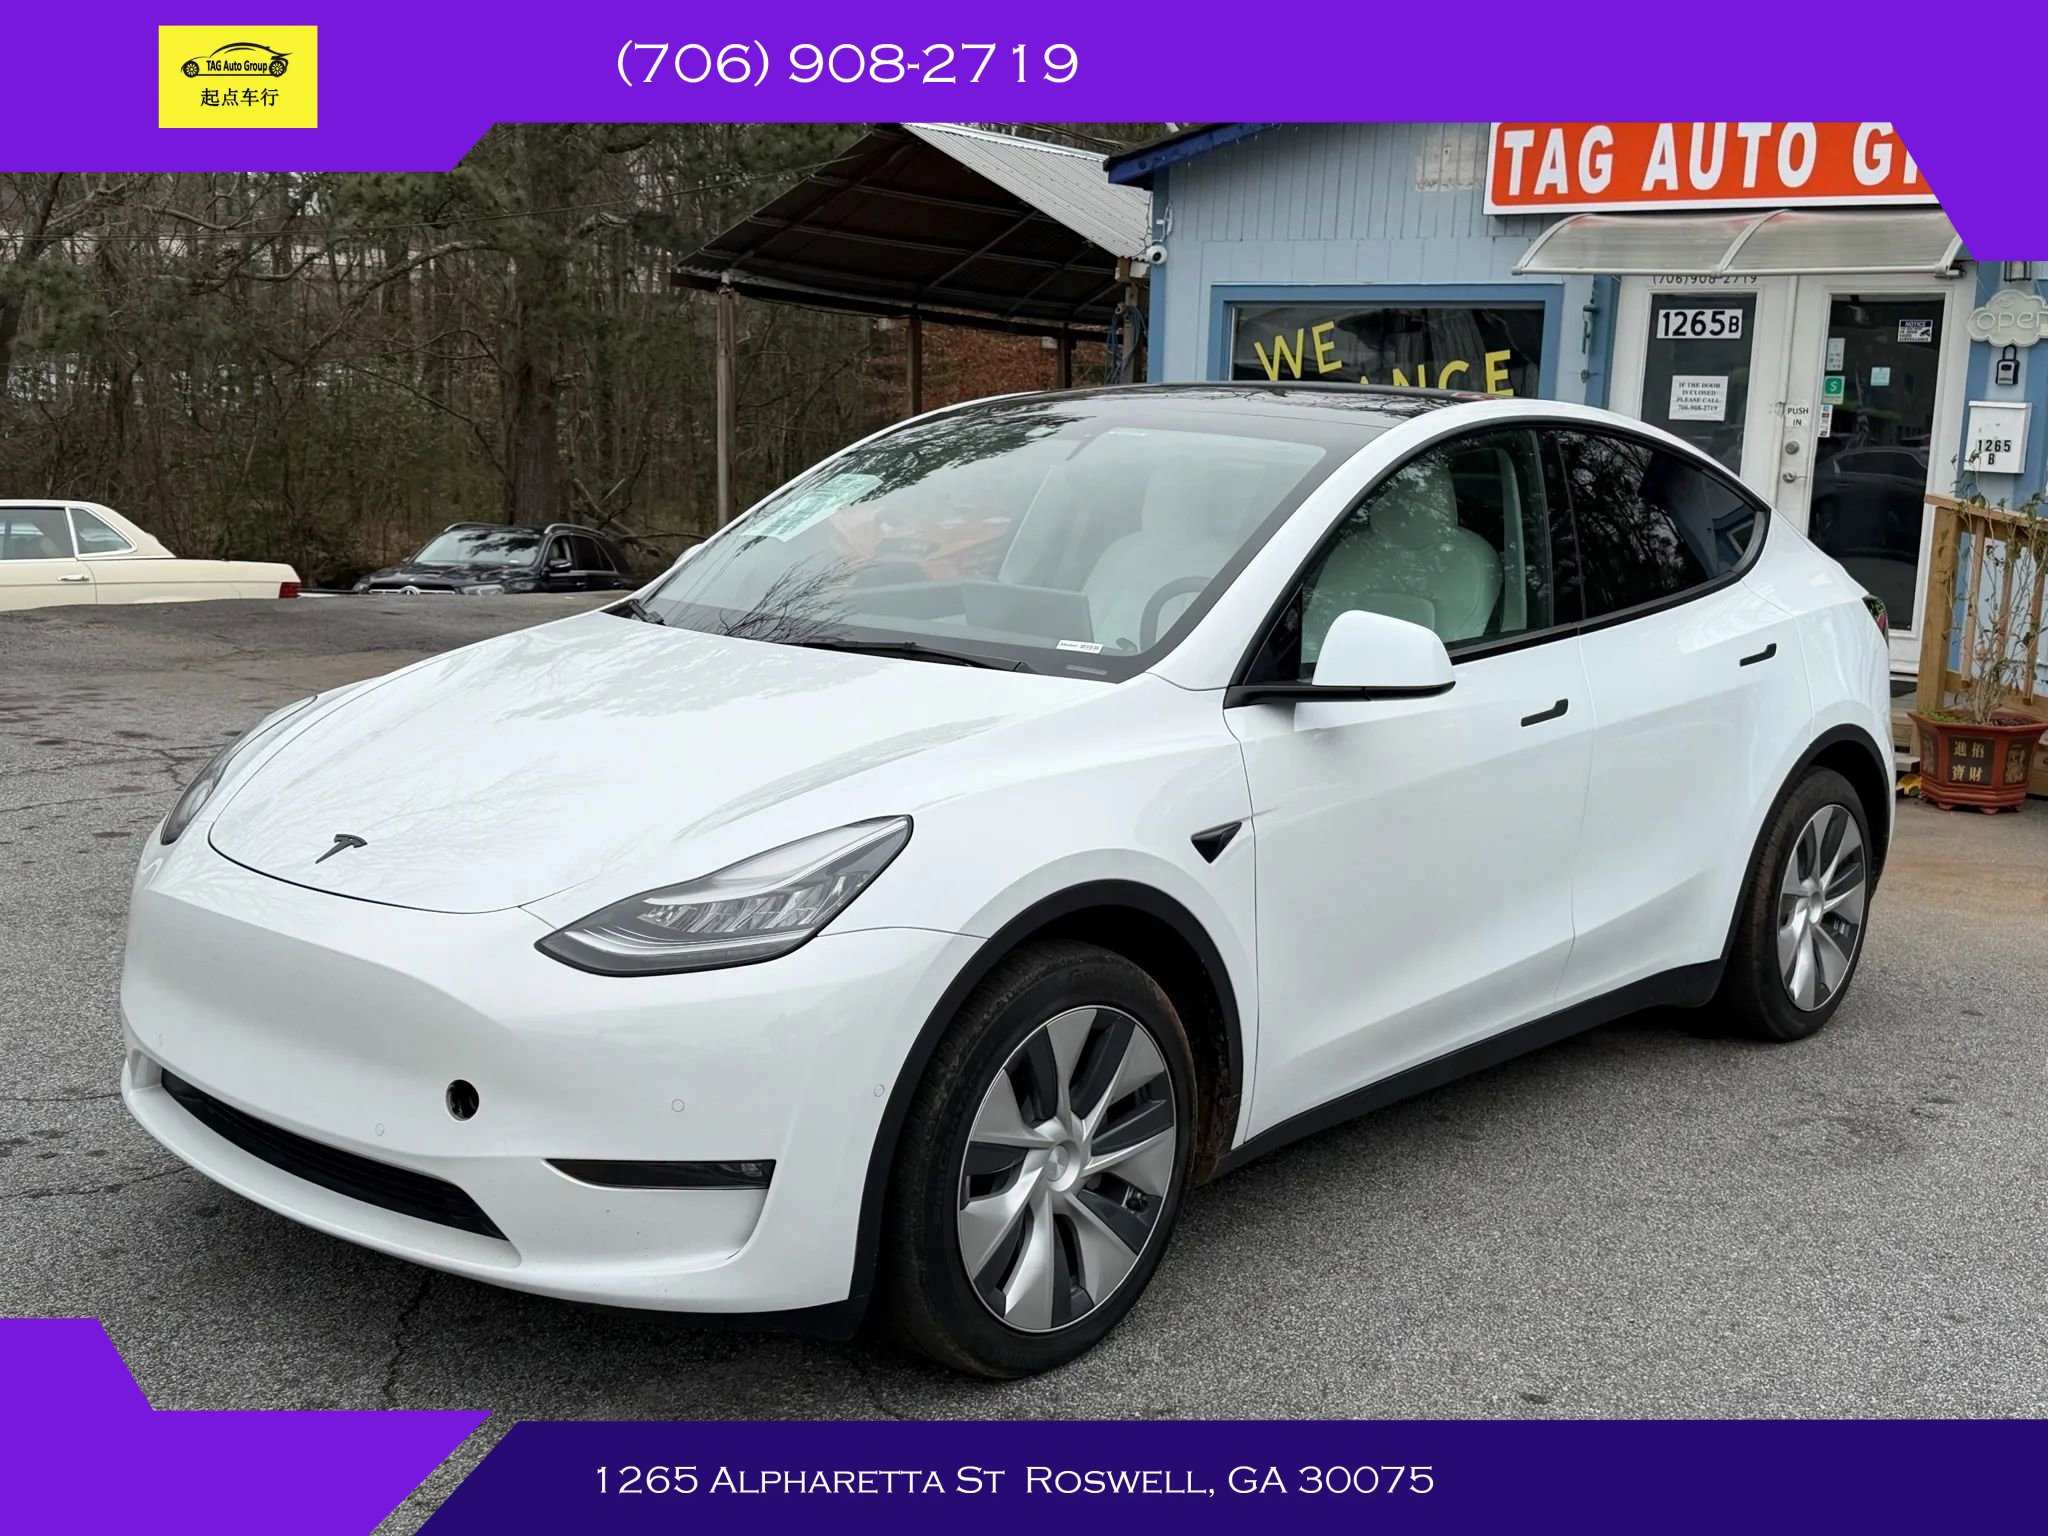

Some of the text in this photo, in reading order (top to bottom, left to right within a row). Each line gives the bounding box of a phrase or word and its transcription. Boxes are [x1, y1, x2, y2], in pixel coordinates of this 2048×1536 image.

[1502, 124, 1615, 196] TAG
[1640, 122, 1817, 191] AUTO
[1253, 320, 1343, 382] WE
[1787, 407, 1809, 415] PUSH
[1792, 418, 1802, 426] IN
[1978, 439, 2012, 453] 1265
[1987, 453, 1996, 465] B
